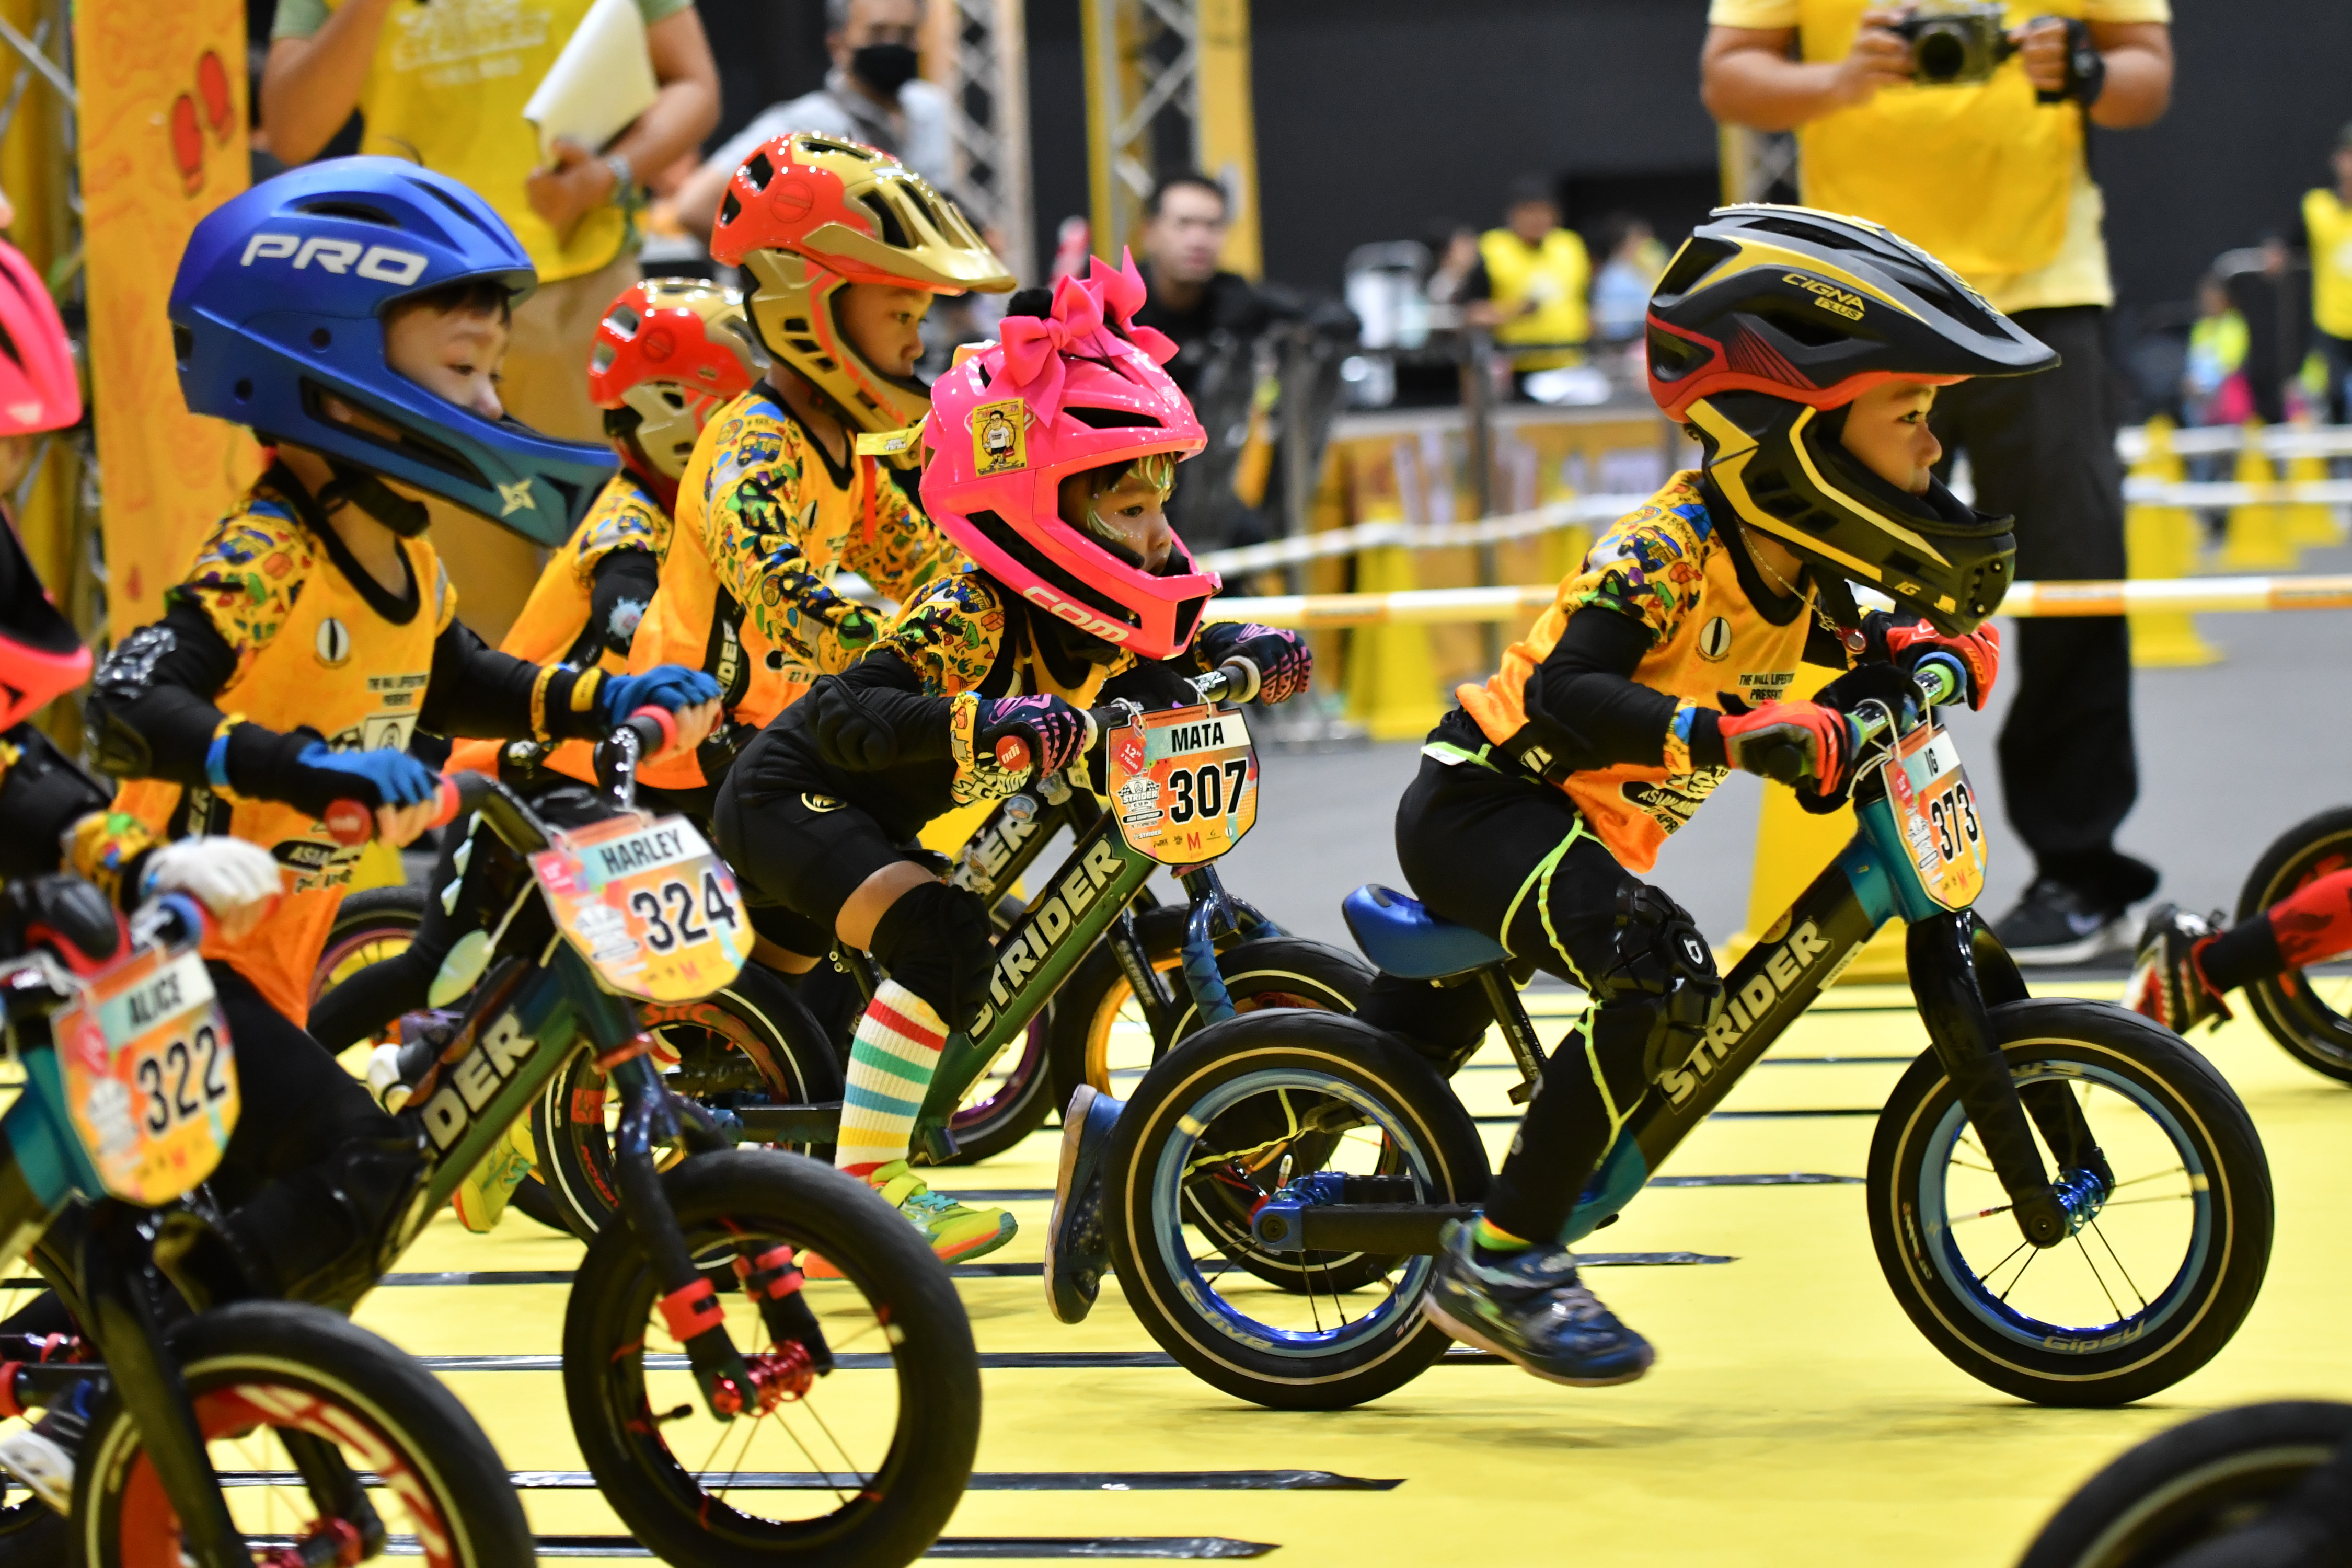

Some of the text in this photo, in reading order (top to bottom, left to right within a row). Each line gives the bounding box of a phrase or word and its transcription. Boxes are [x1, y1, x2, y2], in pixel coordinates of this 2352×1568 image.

[240, 234, 429, 286] PRO
[1781, 272, 1865, 312] CIGNA
[1816, 297, 1862, 319] PLUS
[1171, 722, 1225, 753] MATA
[1124, 755, 1139, 770] YEARS
[1123, 791, 1158, 804] STRIDER
[1169, 759, 1247, 824] 307
[1138, 829, 1162, 839] STRIDER
[1186, 832, 1201, 851] M
[1931, 782, 1978, 862] 373
[599, 828, 684, 875] HARLEY
[631, 871, 737, 951] 324
[128, 972, 182, 1025] ALICE
[1662, 920, 1830, 1105] STRIDER
[139, 1025, 227, 1134] 322
